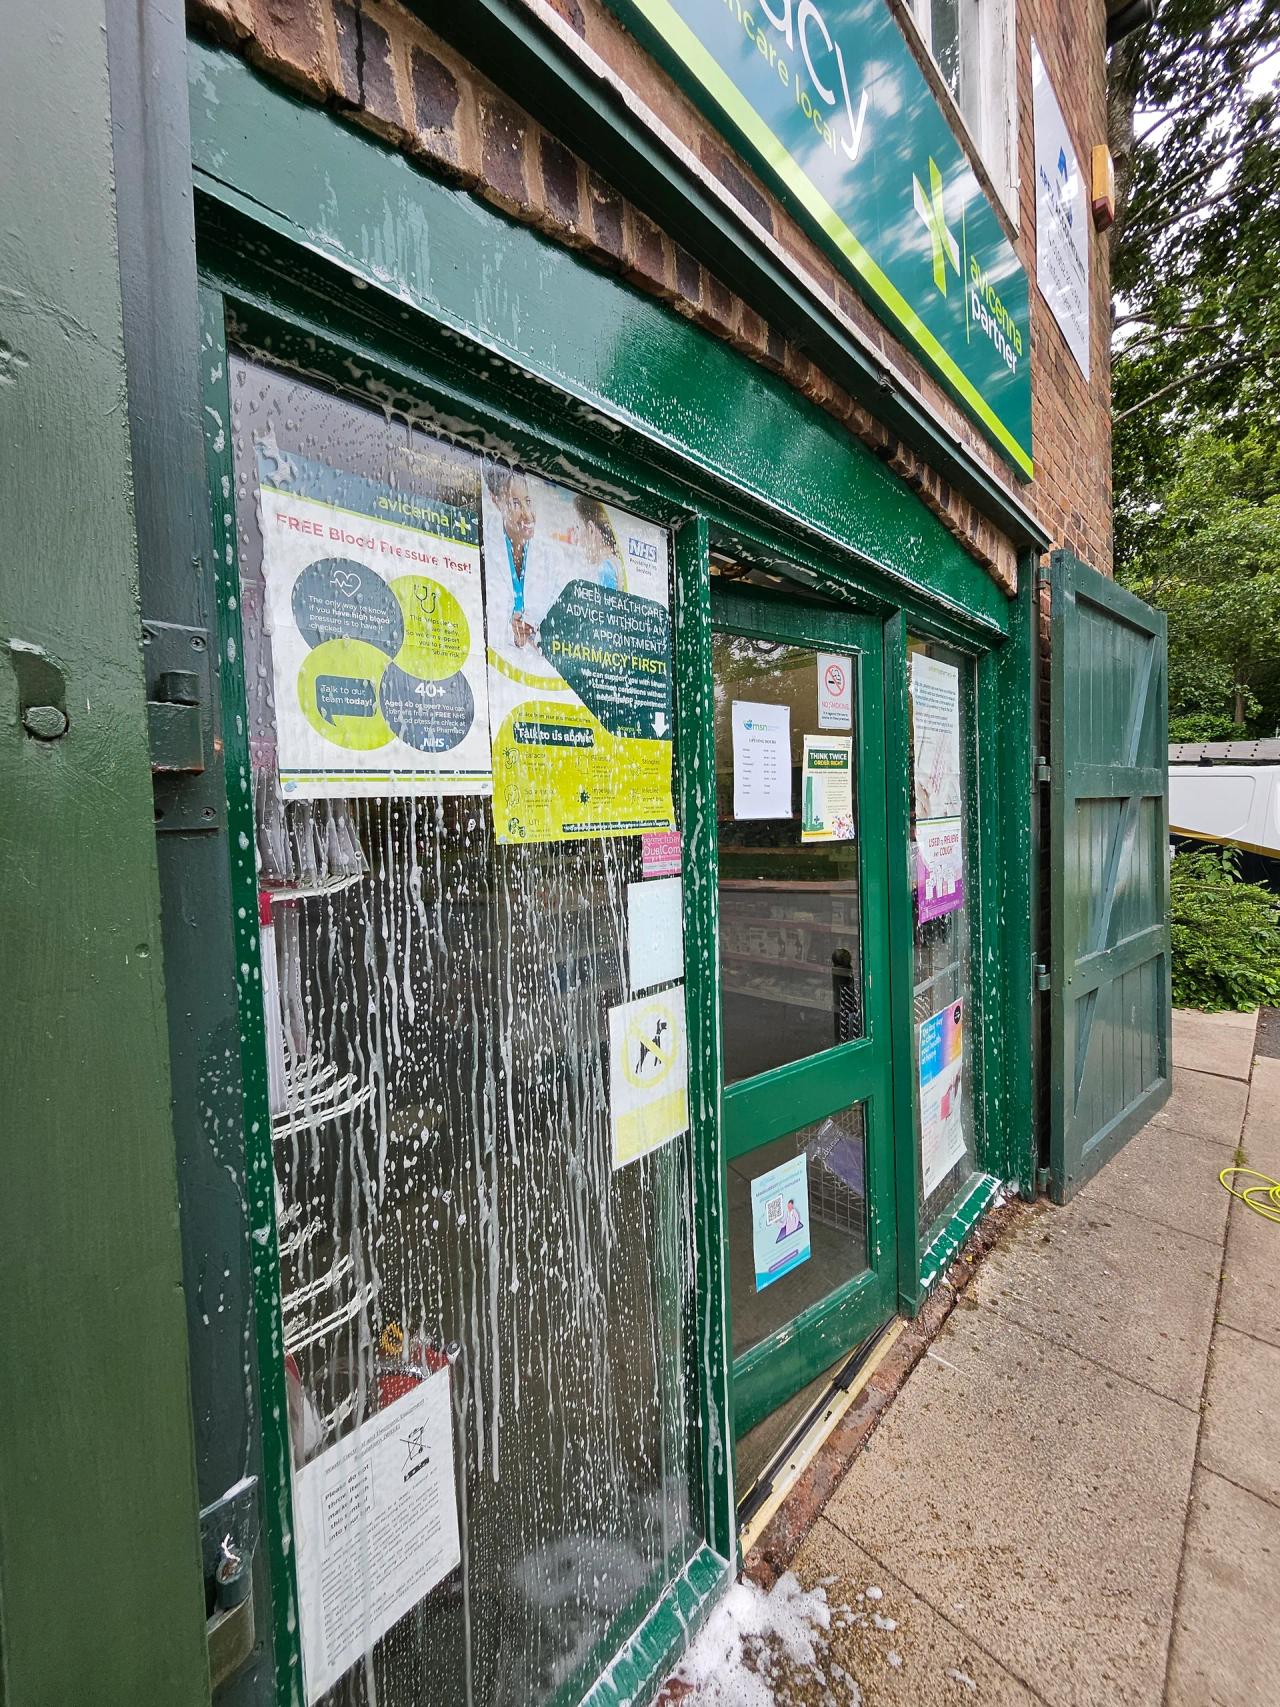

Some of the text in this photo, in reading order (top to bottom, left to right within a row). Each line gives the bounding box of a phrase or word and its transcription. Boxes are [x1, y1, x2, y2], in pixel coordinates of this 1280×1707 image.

[795, 73, 837, 156] local
[970, 255, 1022, 356] avicenna
[970, 289, 1018, 374] partner
[378, 495, 450, 528] avicenna
[276, 513, 472, 574] FREE Blood Pressure Test!
[630, 540, 657, 561] NHS
[309, 595, 323, 604] The
[325, 598, 341, 609] only
[342, 602, 357, 611] way
[369, 606, 387, 616] know
[574, 586, 664, 619] NEED HEALTHCARE
[309, 604, 390, 624] if you have high blood
[566, 603, 665, 636] ADVICE WITHOUT AN
[309, 613, 342, 625] pressure
[344, 618, 350, 626] is
[360, 621, 377, 631] have
[378, 624, 384, 632] it
[437, 635, 460, 643] spport
[593, 629, 667, 653] APPOINTMENT?
[438, 643, 460, 651] pevent
[552, 640, 667, 676] PHARMACY FIRST!
[604, 673, 628, 683] support
[628, 677, 638, 685] you
[639, 678, 650, 686] with
[321, 684, 366, 696] Talk to our
[414, 682, 446, 697] 40+
[592, 682, 667, 699] common conditions without
[321, 695, 373, 707] team today!
[385, 700, 403, 709] Aged
[393, 716, 413, 724] bod
[435, 711, 451, 719] FREE
[452, 712, 465, 720] NHS
[518, 728, 538, 739] Talk
[539, 730, 550, 740] to
[552, 731, 563, 741] us
[423, 737, 445, 748] NHS
[810, 752, 847, 761] THINK TWICE
[928, 837, 940, 848] USED
[644, 845, 681, 856] DualCom
[347, 1473, 356, 1482] do
[330, 1495, 367, 1529] this smbl
[329, 1527, 342, 1541] into
